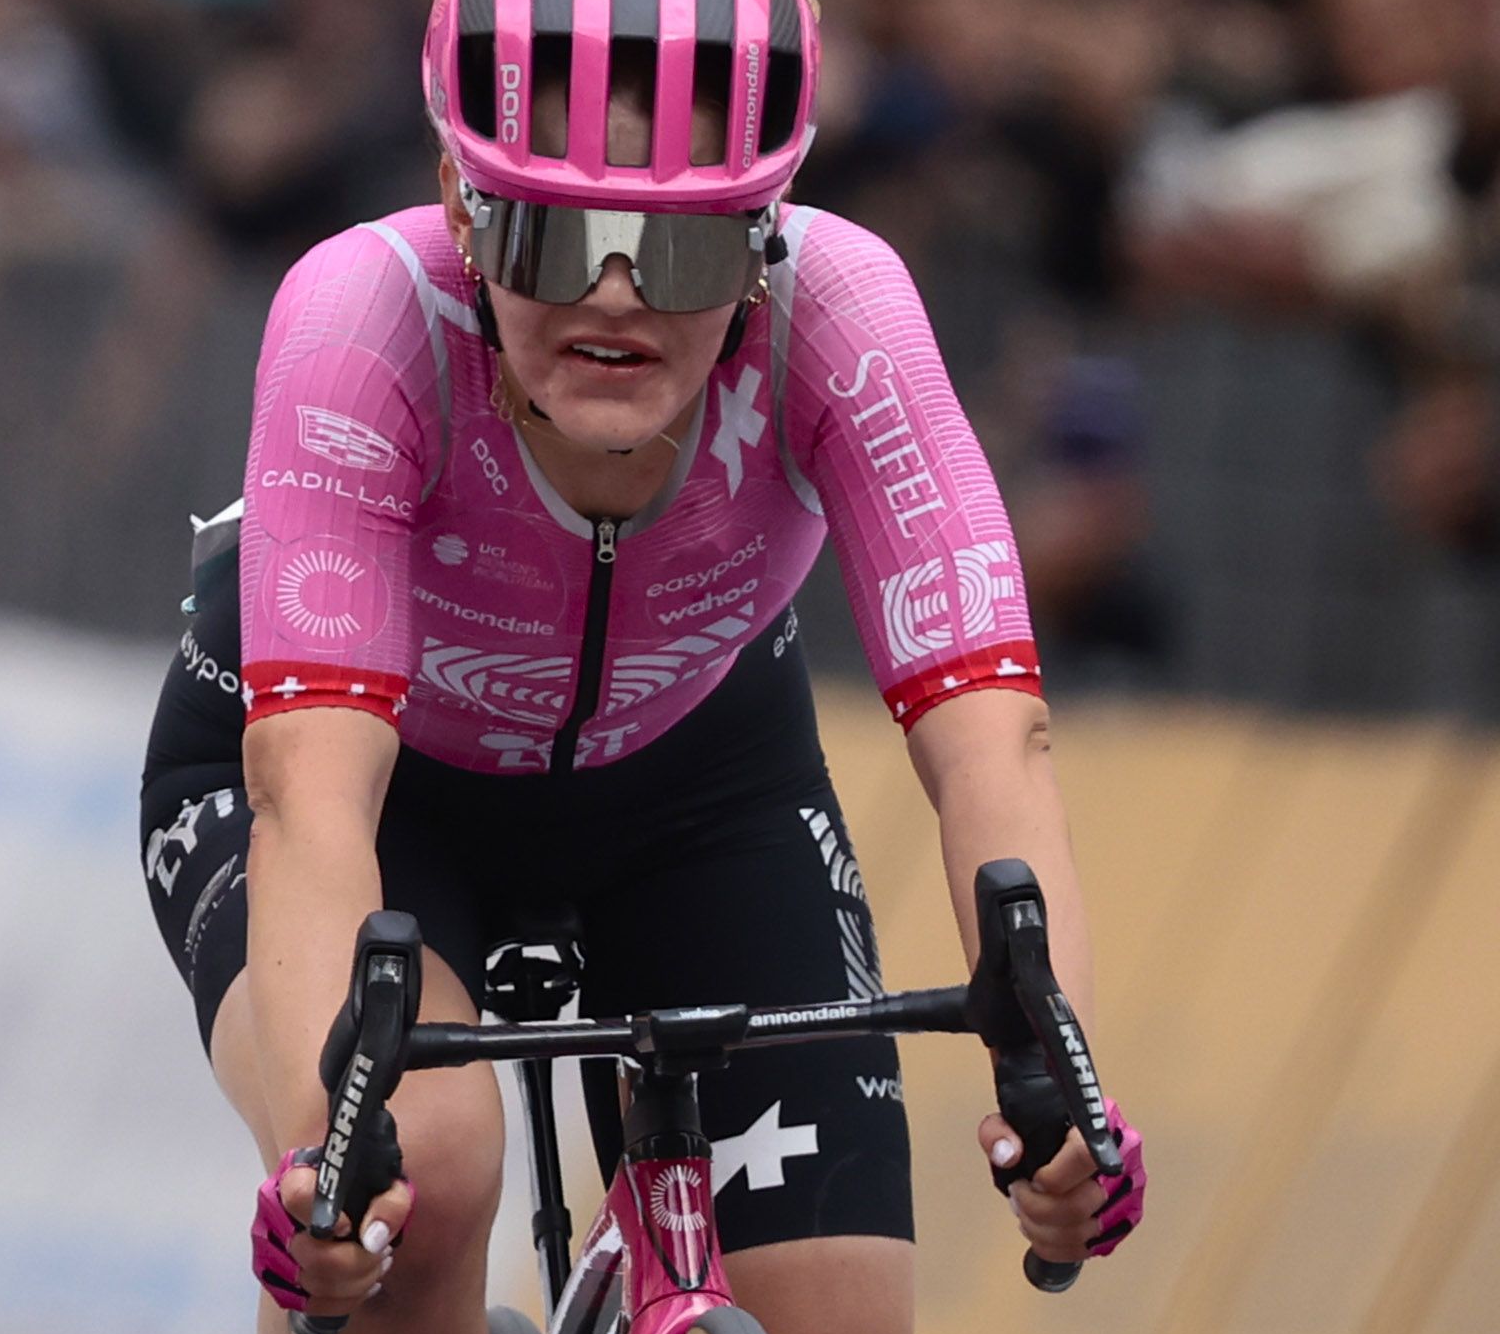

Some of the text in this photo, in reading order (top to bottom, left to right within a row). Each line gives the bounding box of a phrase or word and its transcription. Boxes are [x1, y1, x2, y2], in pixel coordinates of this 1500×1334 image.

[741, 43, 760, 169] cannondale
[827, 347, 947, 539] STIFEL
[261, 469, 413, 516] CADILLAC
[646, 533, 767, 598] easypost
[411, 584, 556, 636] annondale
[658, 578, 759, 626] wahoo
[749, 1005, 858, 1028] annondale
[319, 1053, 375, 1201] SRAM
